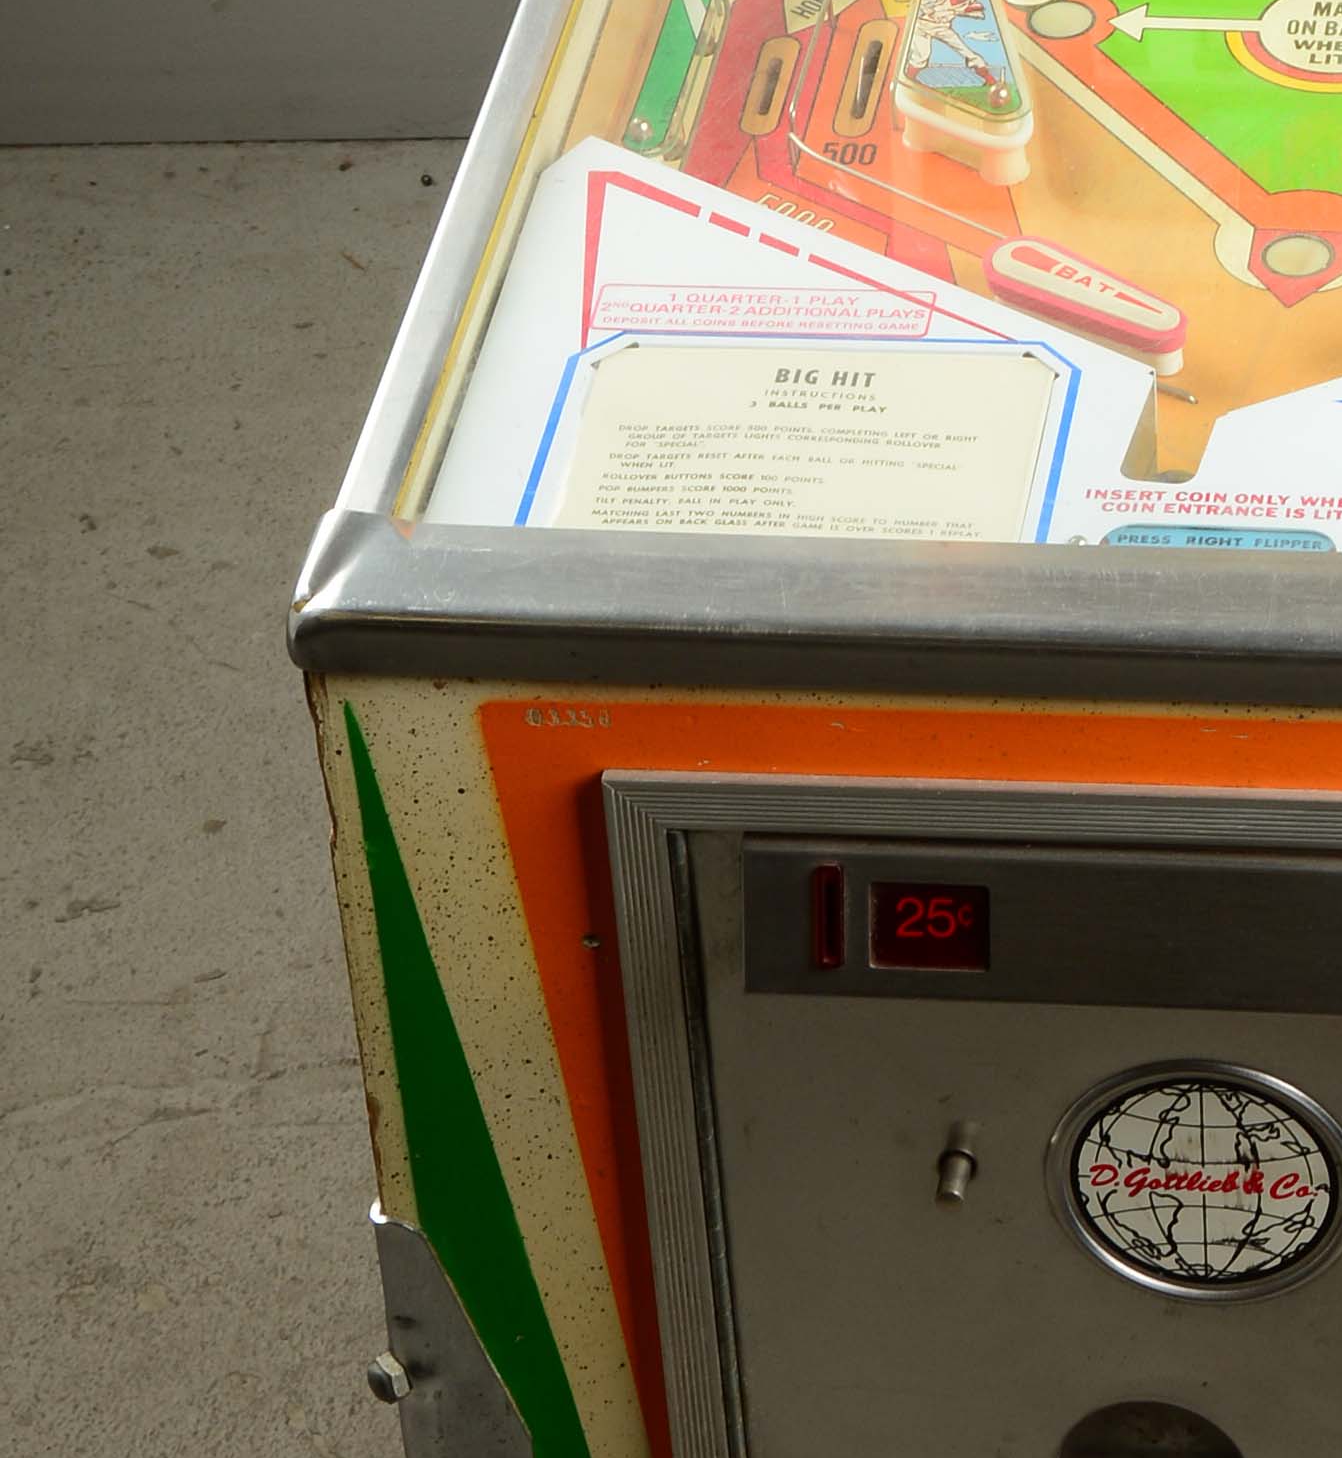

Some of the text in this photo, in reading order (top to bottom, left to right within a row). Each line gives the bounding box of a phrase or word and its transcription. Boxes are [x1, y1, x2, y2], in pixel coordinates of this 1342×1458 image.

[1287, 20, 1316, 35] ON
[823, 142, 877, 165] 500
[1054, 265, 1117, 297] BAT
[809, 296, 860, 305] PLAY
[743, 304, 862, 317] ADDITIONAL
[866, 308, 926, 319] PLAYS
[775, 368, 876, 388] BIG HIT
[765, 389, 877, 401] INSTRUCTIONS
[768, 401, 808, 409] BALLS
[852, 405, 888, 413] PLAY
[1085, 488, 1170, 502] INSERT
[1174, 491, 1227, 503] COIN
[1234, 494, 1291, 505] ONLY
[1102, 502, 1155, 513] COIN
[1163, 504, 1277, 518] ENTRANCE
[1285, 508, 1305, 519] IS
[1116, 534, 1322, 550] PRESS RIGHT FLIPPER
[894, 897, 975, 939] 25¢
[1123, 1167, 1241, 1197] Gottlieb
[1241, 1167, 1265, 1195] &
[1269, 1173, 1319, 1199] Co.
